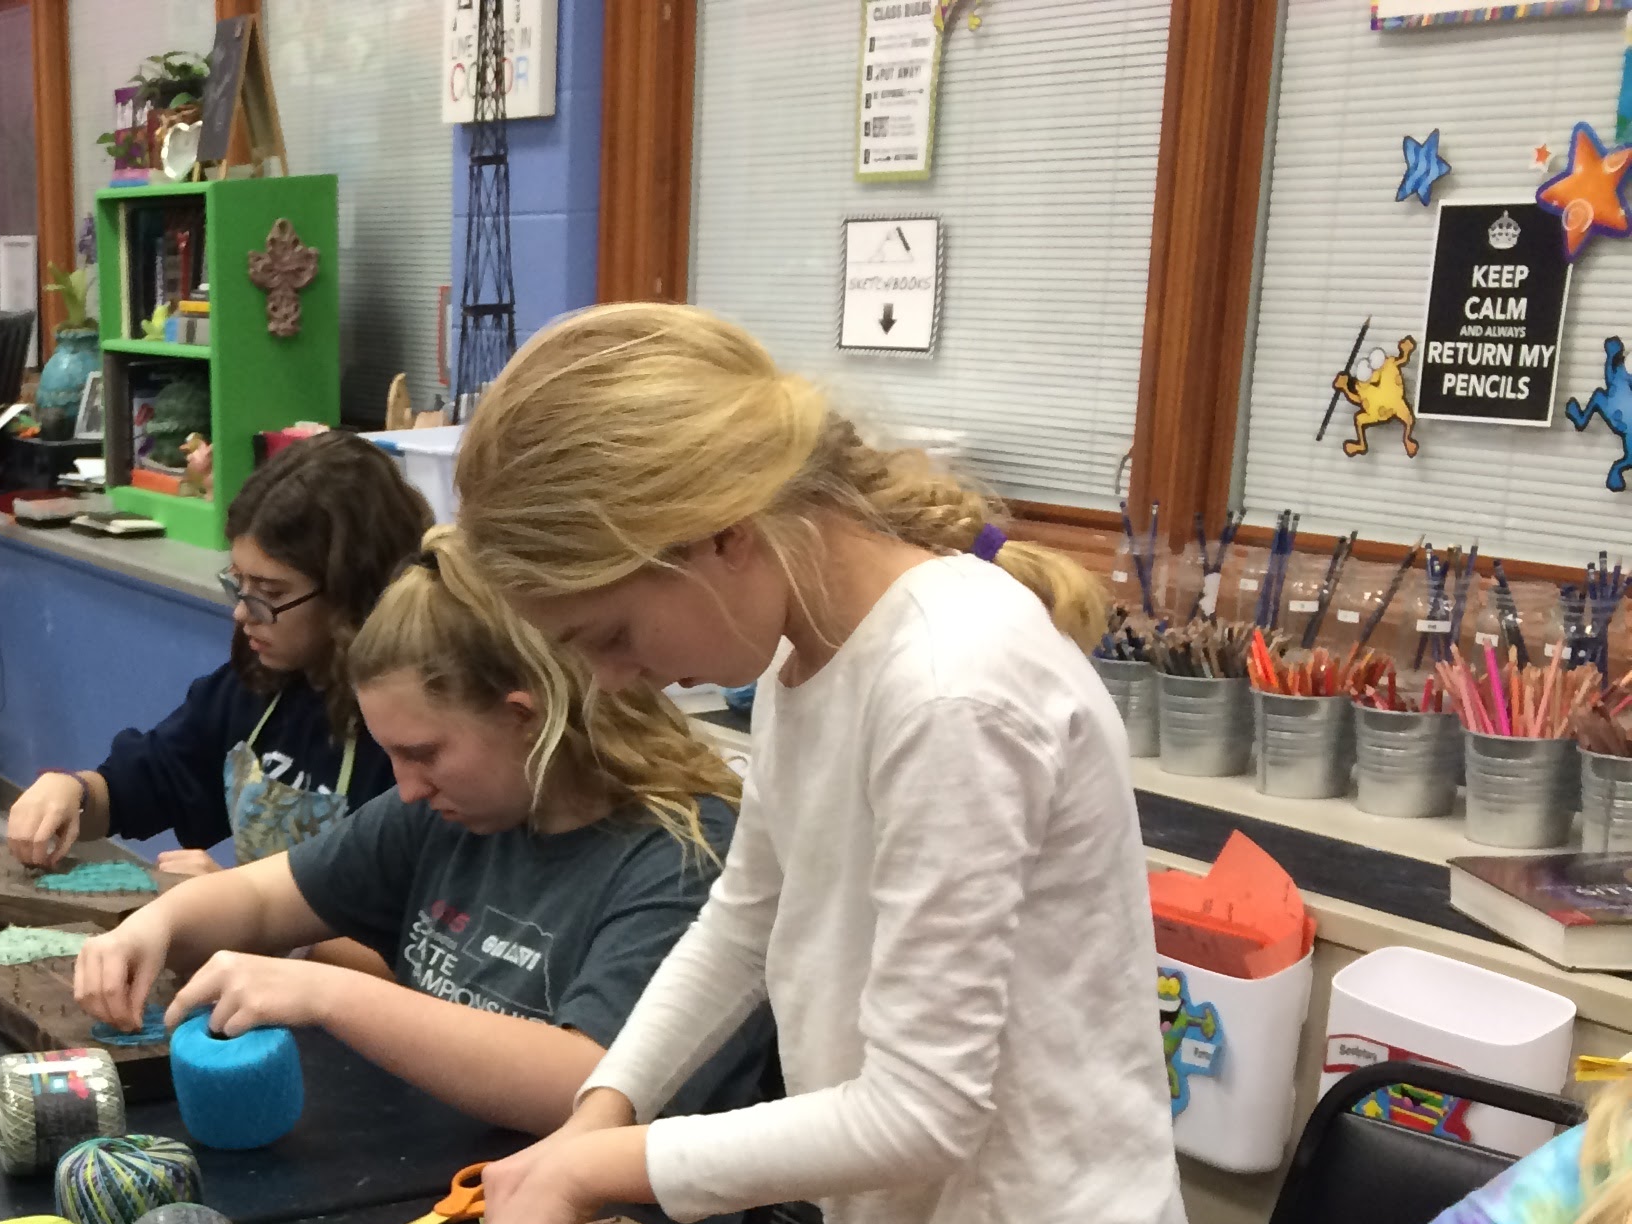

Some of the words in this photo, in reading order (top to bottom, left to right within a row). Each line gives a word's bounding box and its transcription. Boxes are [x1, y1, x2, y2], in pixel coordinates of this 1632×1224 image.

[873, 5, 902, 21] CLASS
[1472, 265, 1530, 288] KEEP
[1465, 296, 1528, 320] CALM
[1460, 325, 1483, 337] AND
[1484, 326, 1526, 338] ALWAYS
[1427, 341, 1514, 366] RETURN
[1519, 344, 1556, 368] MY
[1442, 373, 1531, 400] PENCILS
